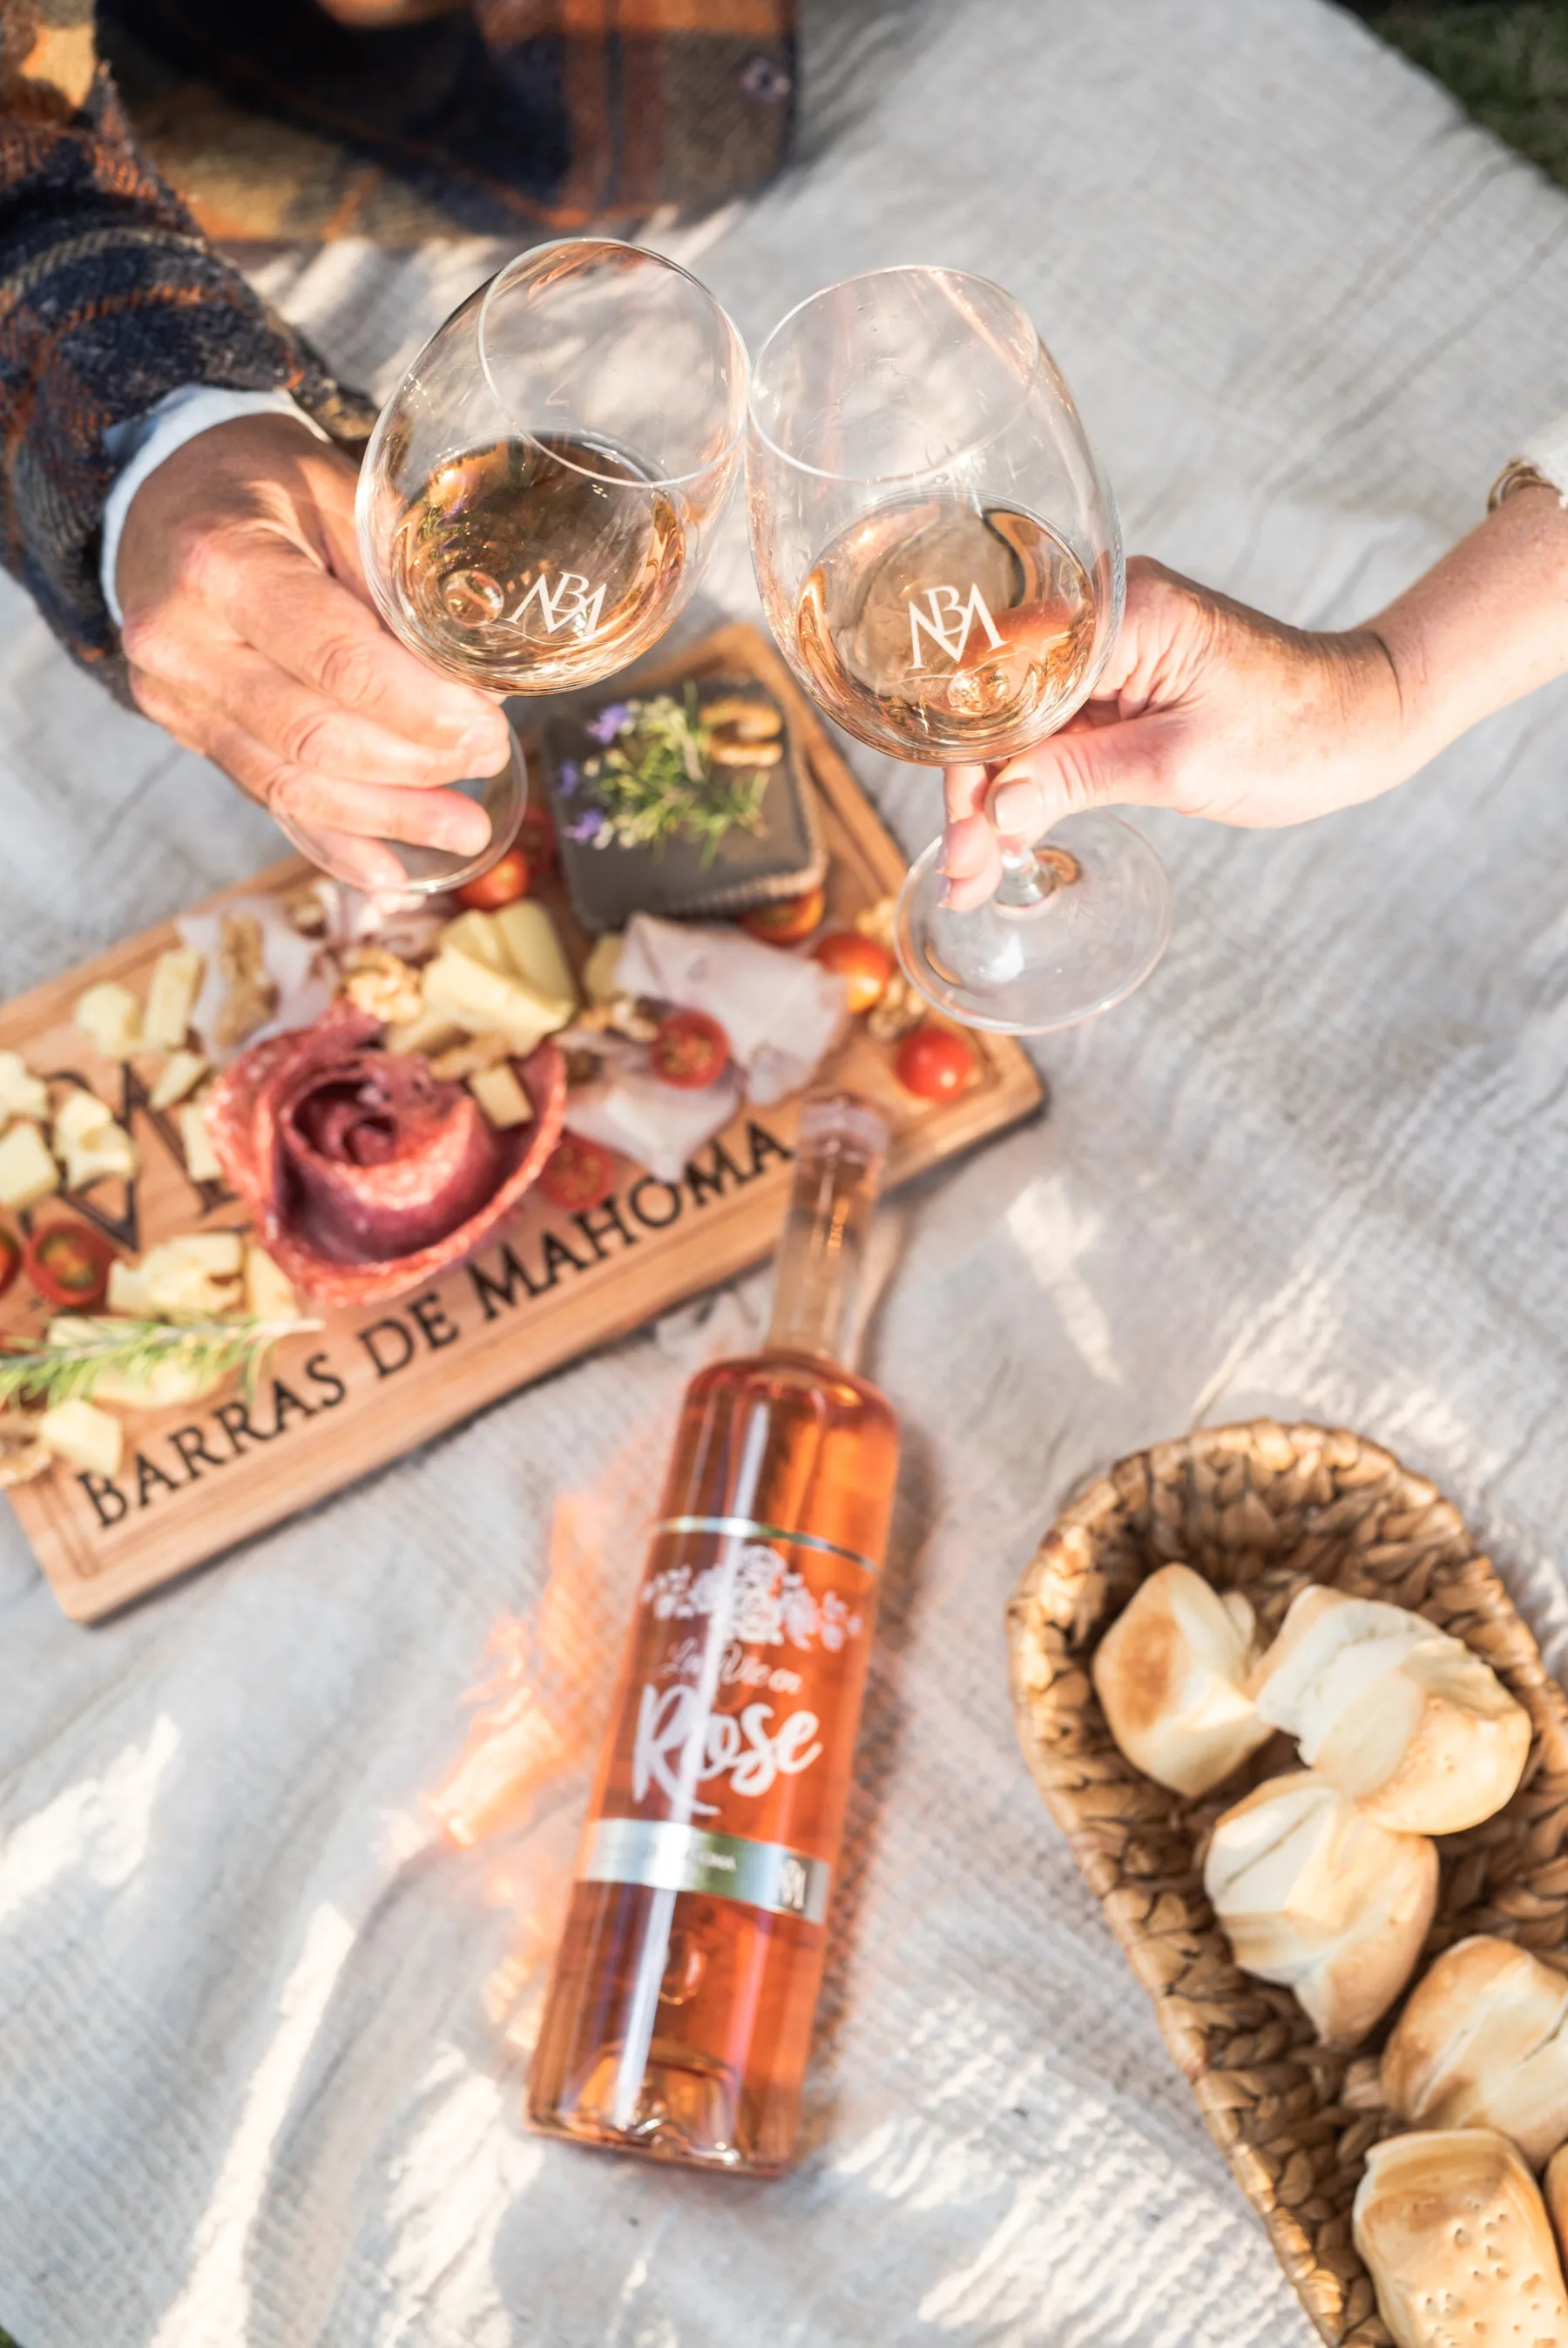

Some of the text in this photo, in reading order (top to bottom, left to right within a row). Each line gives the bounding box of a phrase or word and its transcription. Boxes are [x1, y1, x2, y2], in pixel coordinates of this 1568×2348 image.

[77, 1353, 346, 1527] BARRAS
[357, 1292, 460, 1378] DE
[463, 1120, 794, 1321] MAHOMA
[631, 1682, 823, 1817] Rose
